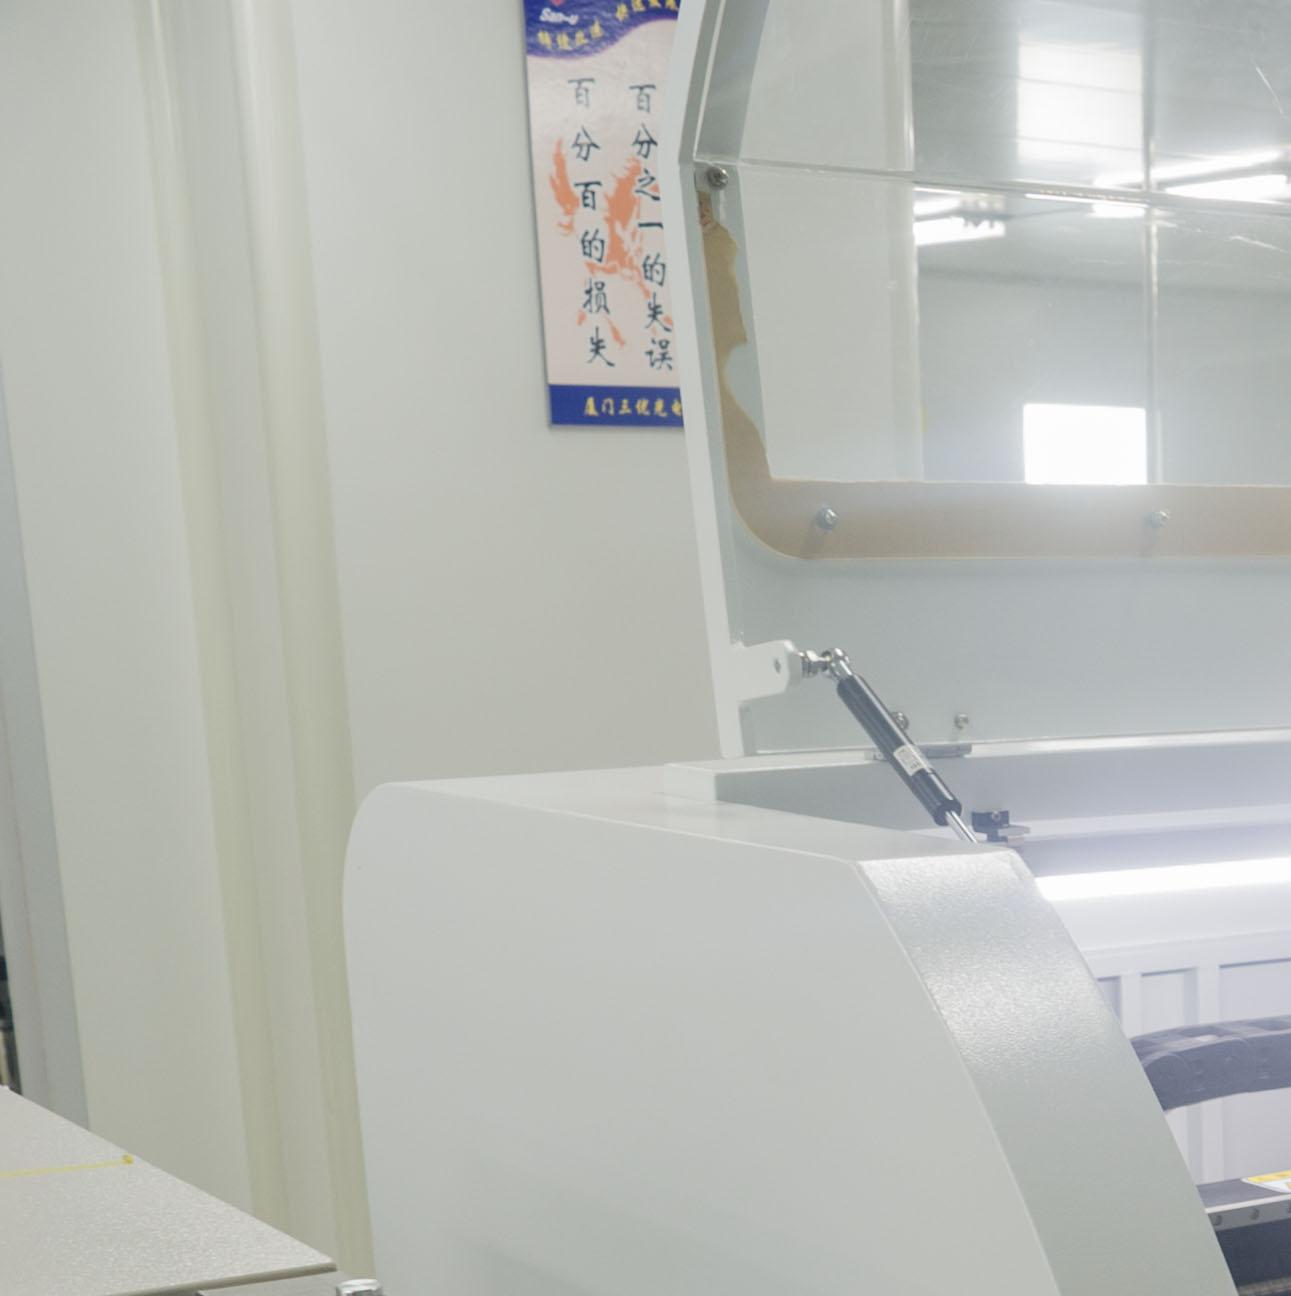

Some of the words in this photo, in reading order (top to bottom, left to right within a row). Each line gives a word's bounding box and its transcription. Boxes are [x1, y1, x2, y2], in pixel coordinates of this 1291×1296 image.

[568, 77, 616, 368] 百分百的损失
[629, 84, 674, 371] 百分之一的失误
